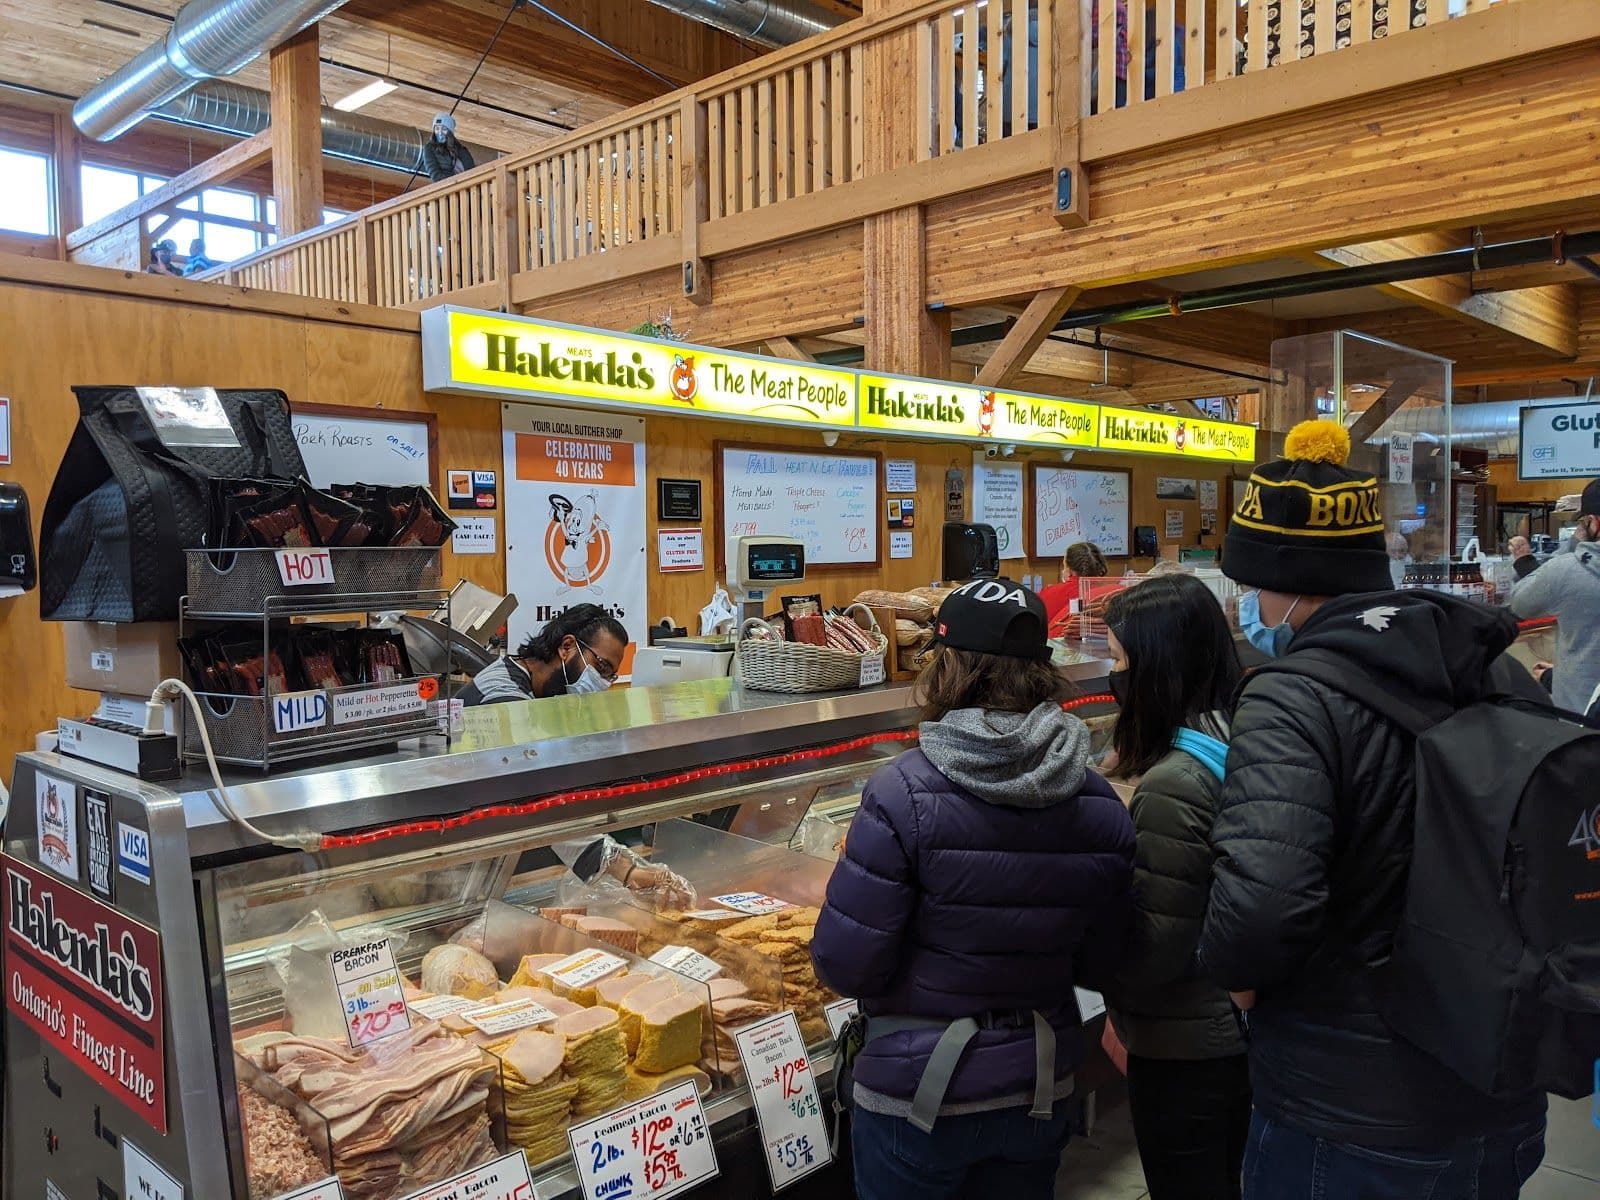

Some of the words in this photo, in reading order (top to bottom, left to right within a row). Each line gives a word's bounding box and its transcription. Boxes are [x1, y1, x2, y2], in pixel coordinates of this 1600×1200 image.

[482, 332, 655, 390] Halenda's
[566, 346, 592, 357] MEATS
[711, 363, 744, 394] The
[751, 369, 793, 399] Meat
[798, 375, 847, 410] People
[867, 386, 964, 424] Halenda's
[532, 420, 550, 432] YOUR
[552, 423, 573, 435] LOCAL
[575, 425, 604, 437] BUTCHER
[606, 428, 622, 439] SHOP
[1006, 401, 1027, 424] The
[1030, 405, 1057, 428] Meat
[1060, 408, 1091, 436] People
[1105, 415, 1168, 444] Halenda's
[545, 440, 612, 461] CELEBRATING
[1193, 425, 1206, 444] The
[1208, 428, 1227, 447] Meat
[1228, 431, 1250, 453] People
[555, 460, 569, 477] 40
[572, 461, 604, 480] YEARS
[746, 454, 777, 474] FALL
[477, 473, 494, 482] VISA
[283, 554, 328, 581] HOT
[277, 694, 327, 730] MILD
[336, 697, 354, 708] Mild
[365, 694, 378, 704] Hot
[87, 801, 107, 839] EAT
[123, 829, 147, 860] VISA
[89, 860, 110, 889] PORK
[7, 867, 154, 1022] Halenda's
[334, 938, 389, 963] BREAKFAST
[344, 952, 379, 972] BACON
[347, 1000, 356, 1014] 3
[13, 971, 67, 1039] Ontario's
[72, 1012, 116, 1077] Finest
[118, 1046, 154, 1105] Line
[751, 1042, 777, 1057] Canadian
[779, 1035, 794, 1046] Back
[640, 1103, 667, 1120] Bacon
[669, 1135, 679, 1147] OR
[591, 1141, 607, 1174] 2
[465, 1173, 499, 1195] Bacon
[595, 1172, 634, 1198] CHUNK
